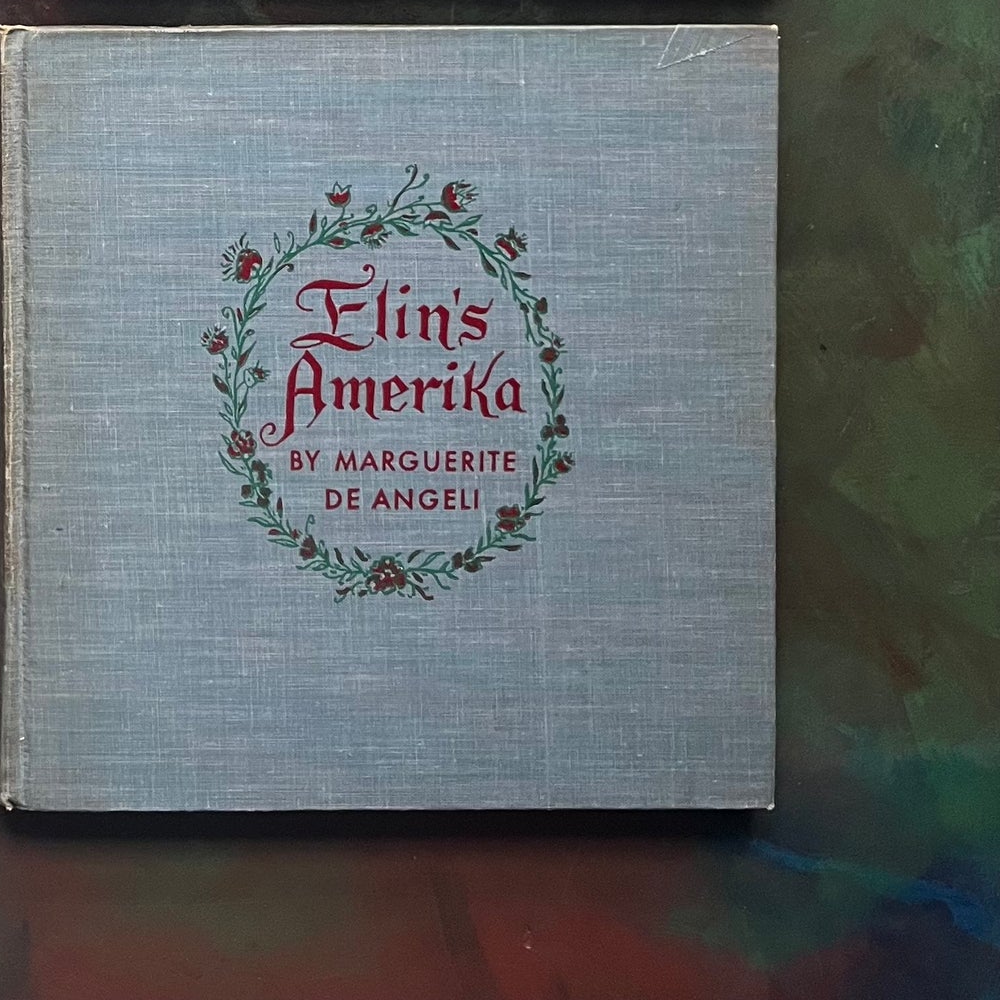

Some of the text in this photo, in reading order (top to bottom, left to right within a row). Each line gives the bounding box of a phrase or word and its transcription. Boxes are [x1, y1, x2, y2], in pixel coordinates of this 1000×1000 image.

[289, 264, 494, 351] Elin's
[290, 449, 517, 473] BY MARGUERITE
[325, 487, 481, 511] DE ANGELI
